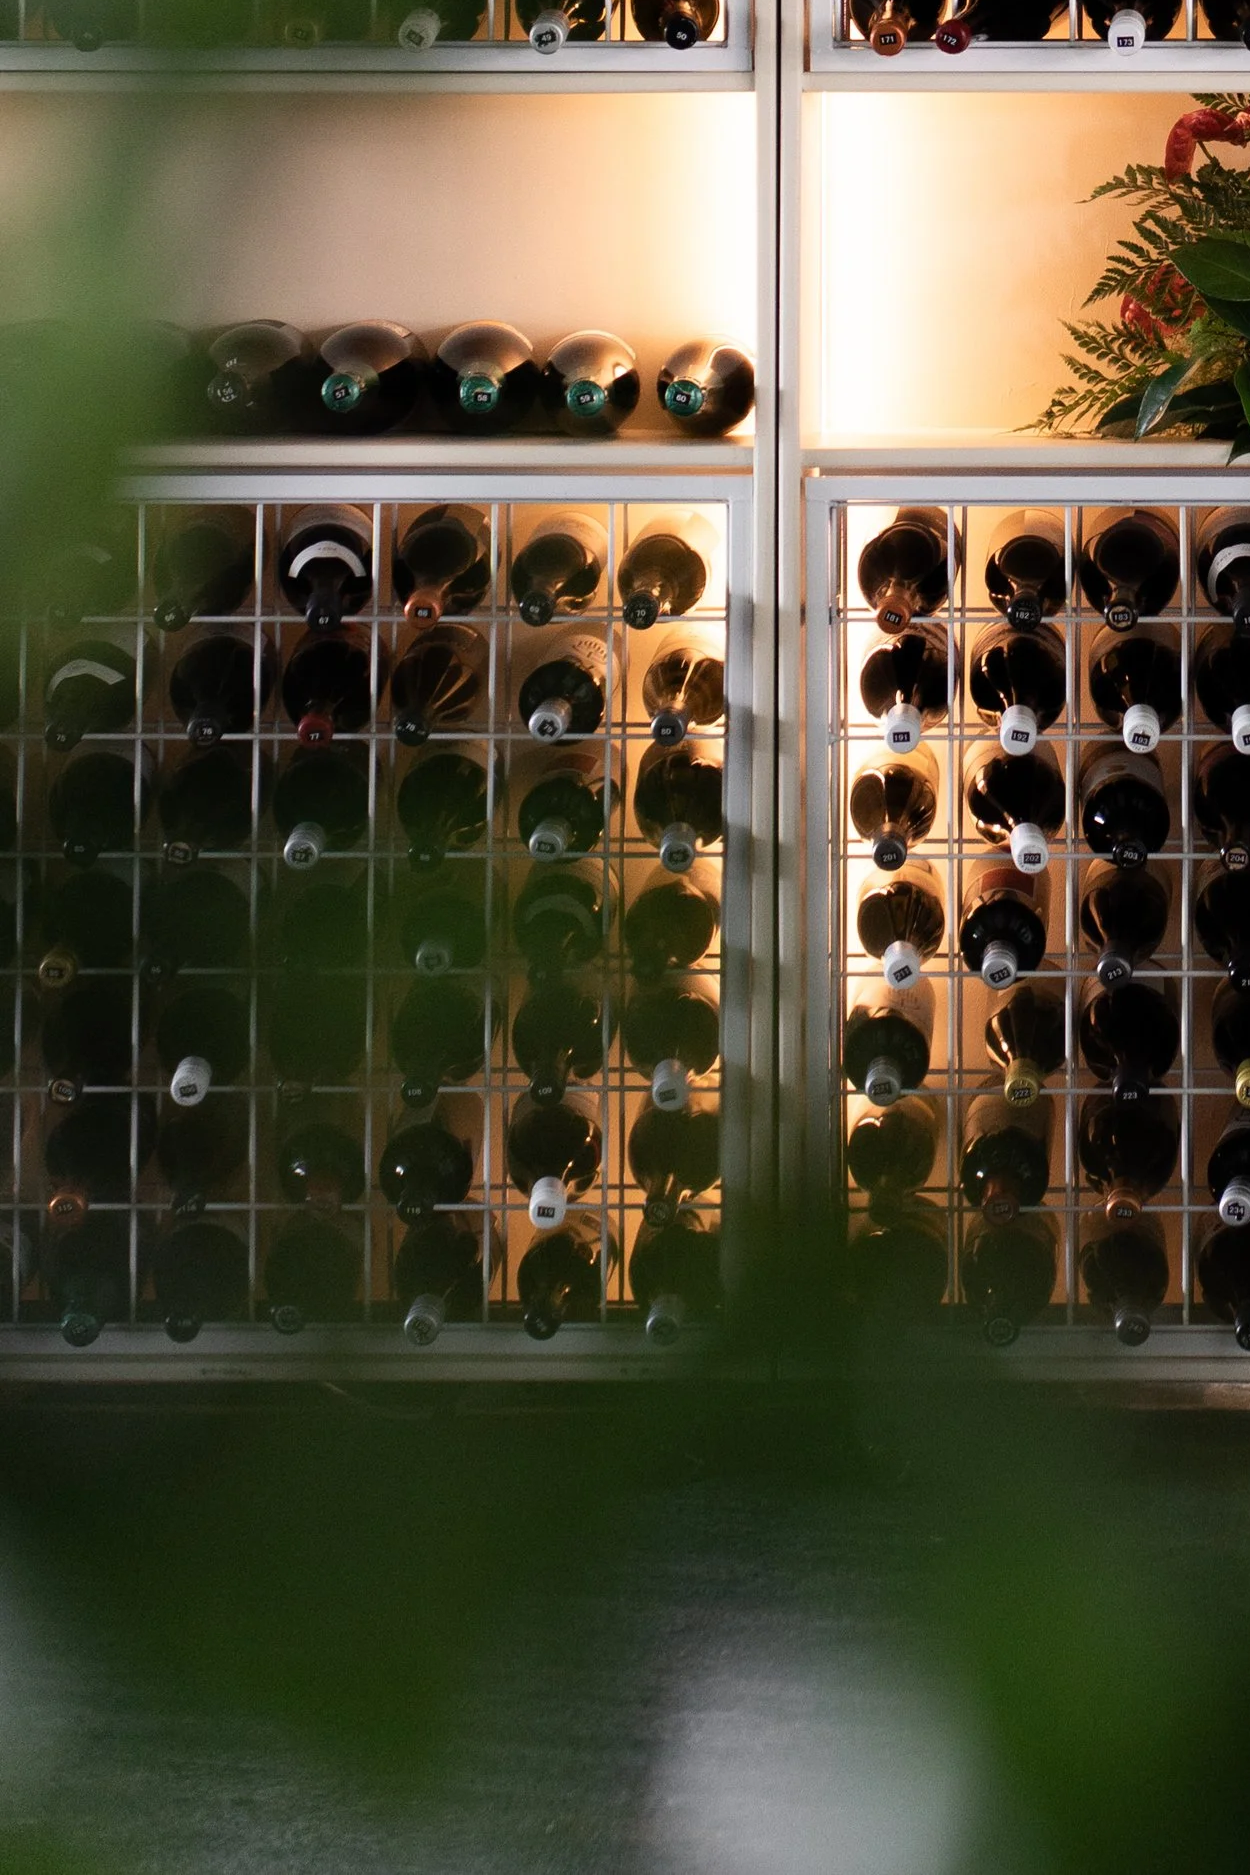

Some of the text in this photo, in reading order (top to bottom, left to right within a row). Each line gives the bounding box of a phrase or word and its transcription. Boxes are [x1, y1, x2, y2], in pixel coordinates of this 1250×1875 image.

[676, 31, 687, 40] 50
[943, 35, 957, 45] 172
[335, 389, 345, 398] 57
[477, 394, 488, 402] 58
[676, 394, 687, 402] 60
[580, 394, 590, 403] 59
[529, 605, 540, 614] 69
[636, 609, 646, 617] 70
[886, 613, 899, 623] 181
[1013, 733, 1027, 741] 192
[1134, 736, 1148, 745] 193
[1123, 851, 1138, 860] 203
[994, 970, 1008, 981] 212
